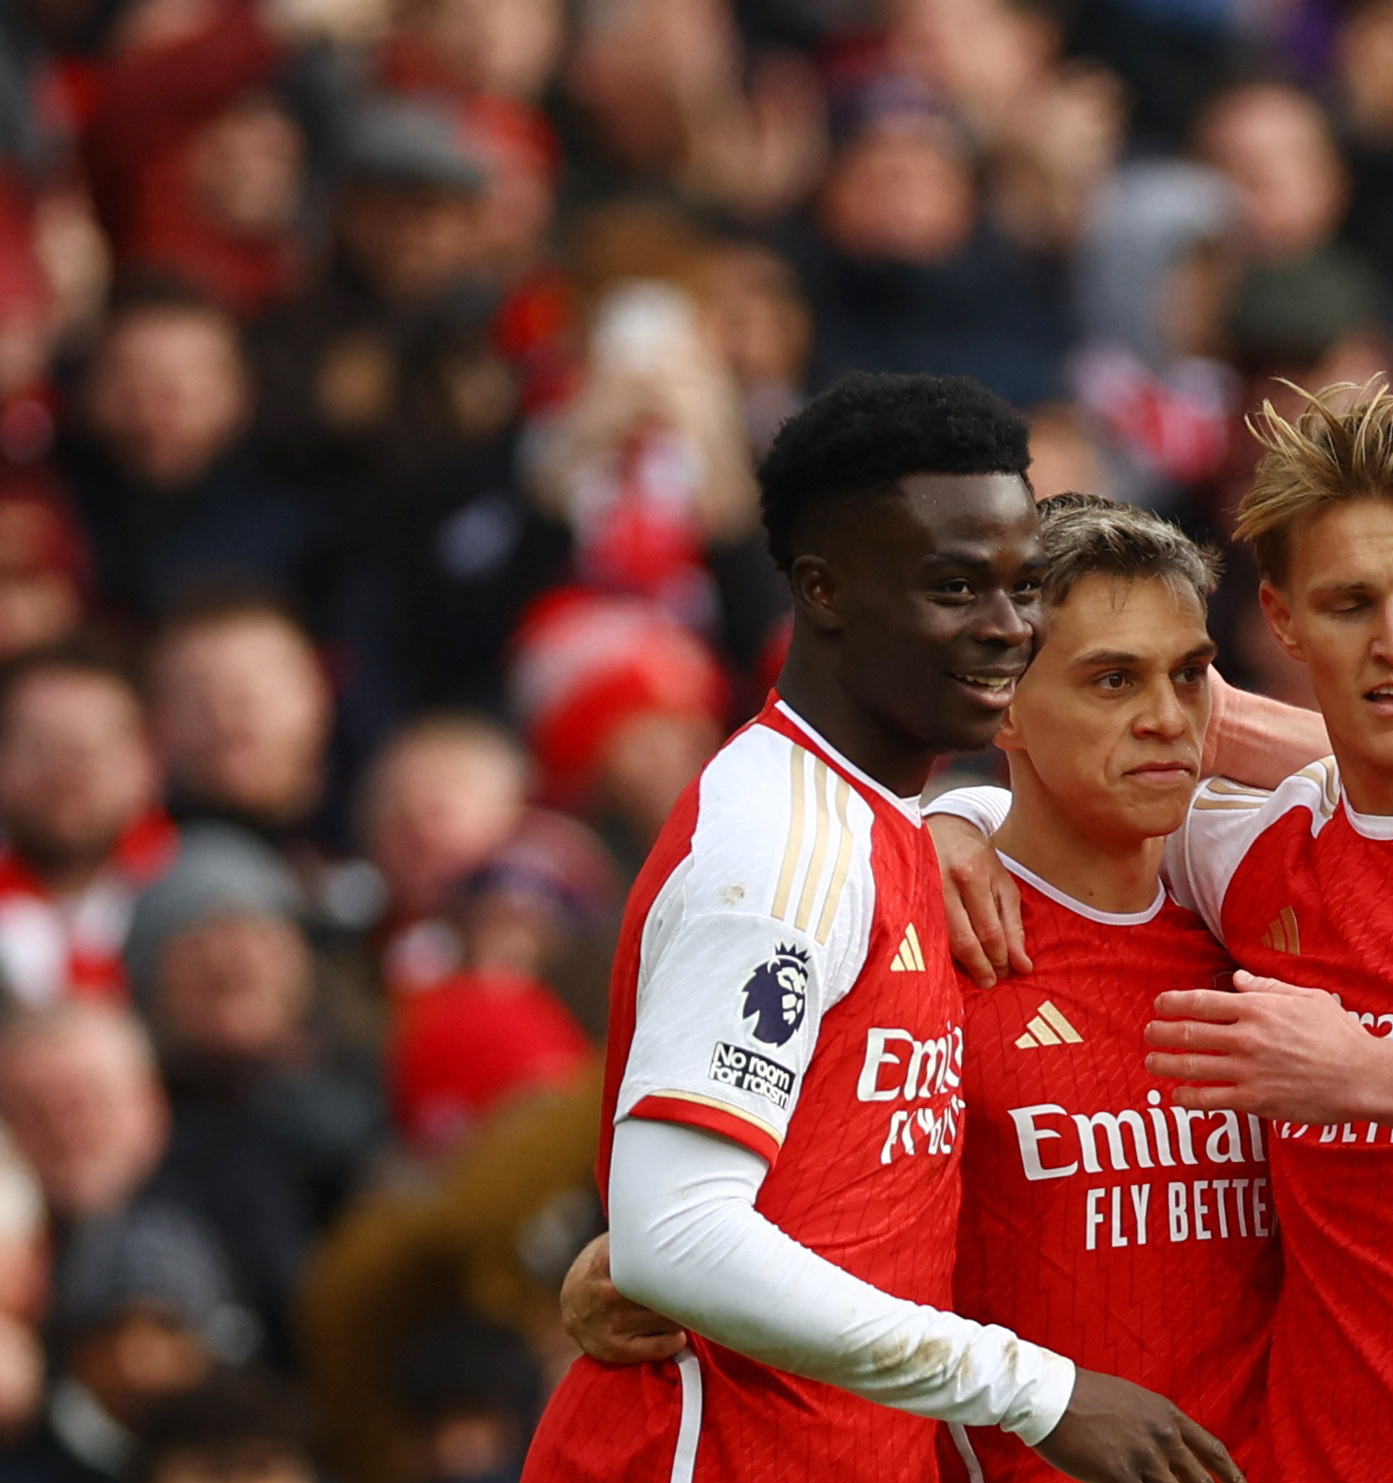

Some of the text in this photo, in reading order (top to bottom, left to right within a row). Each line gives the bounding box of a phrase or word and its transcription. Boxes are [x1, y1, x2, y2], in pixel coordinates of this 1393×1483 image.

[713, 1042, 791, 1091] No room
[1085, 1177, 1278, 1251] FLY BETTE
